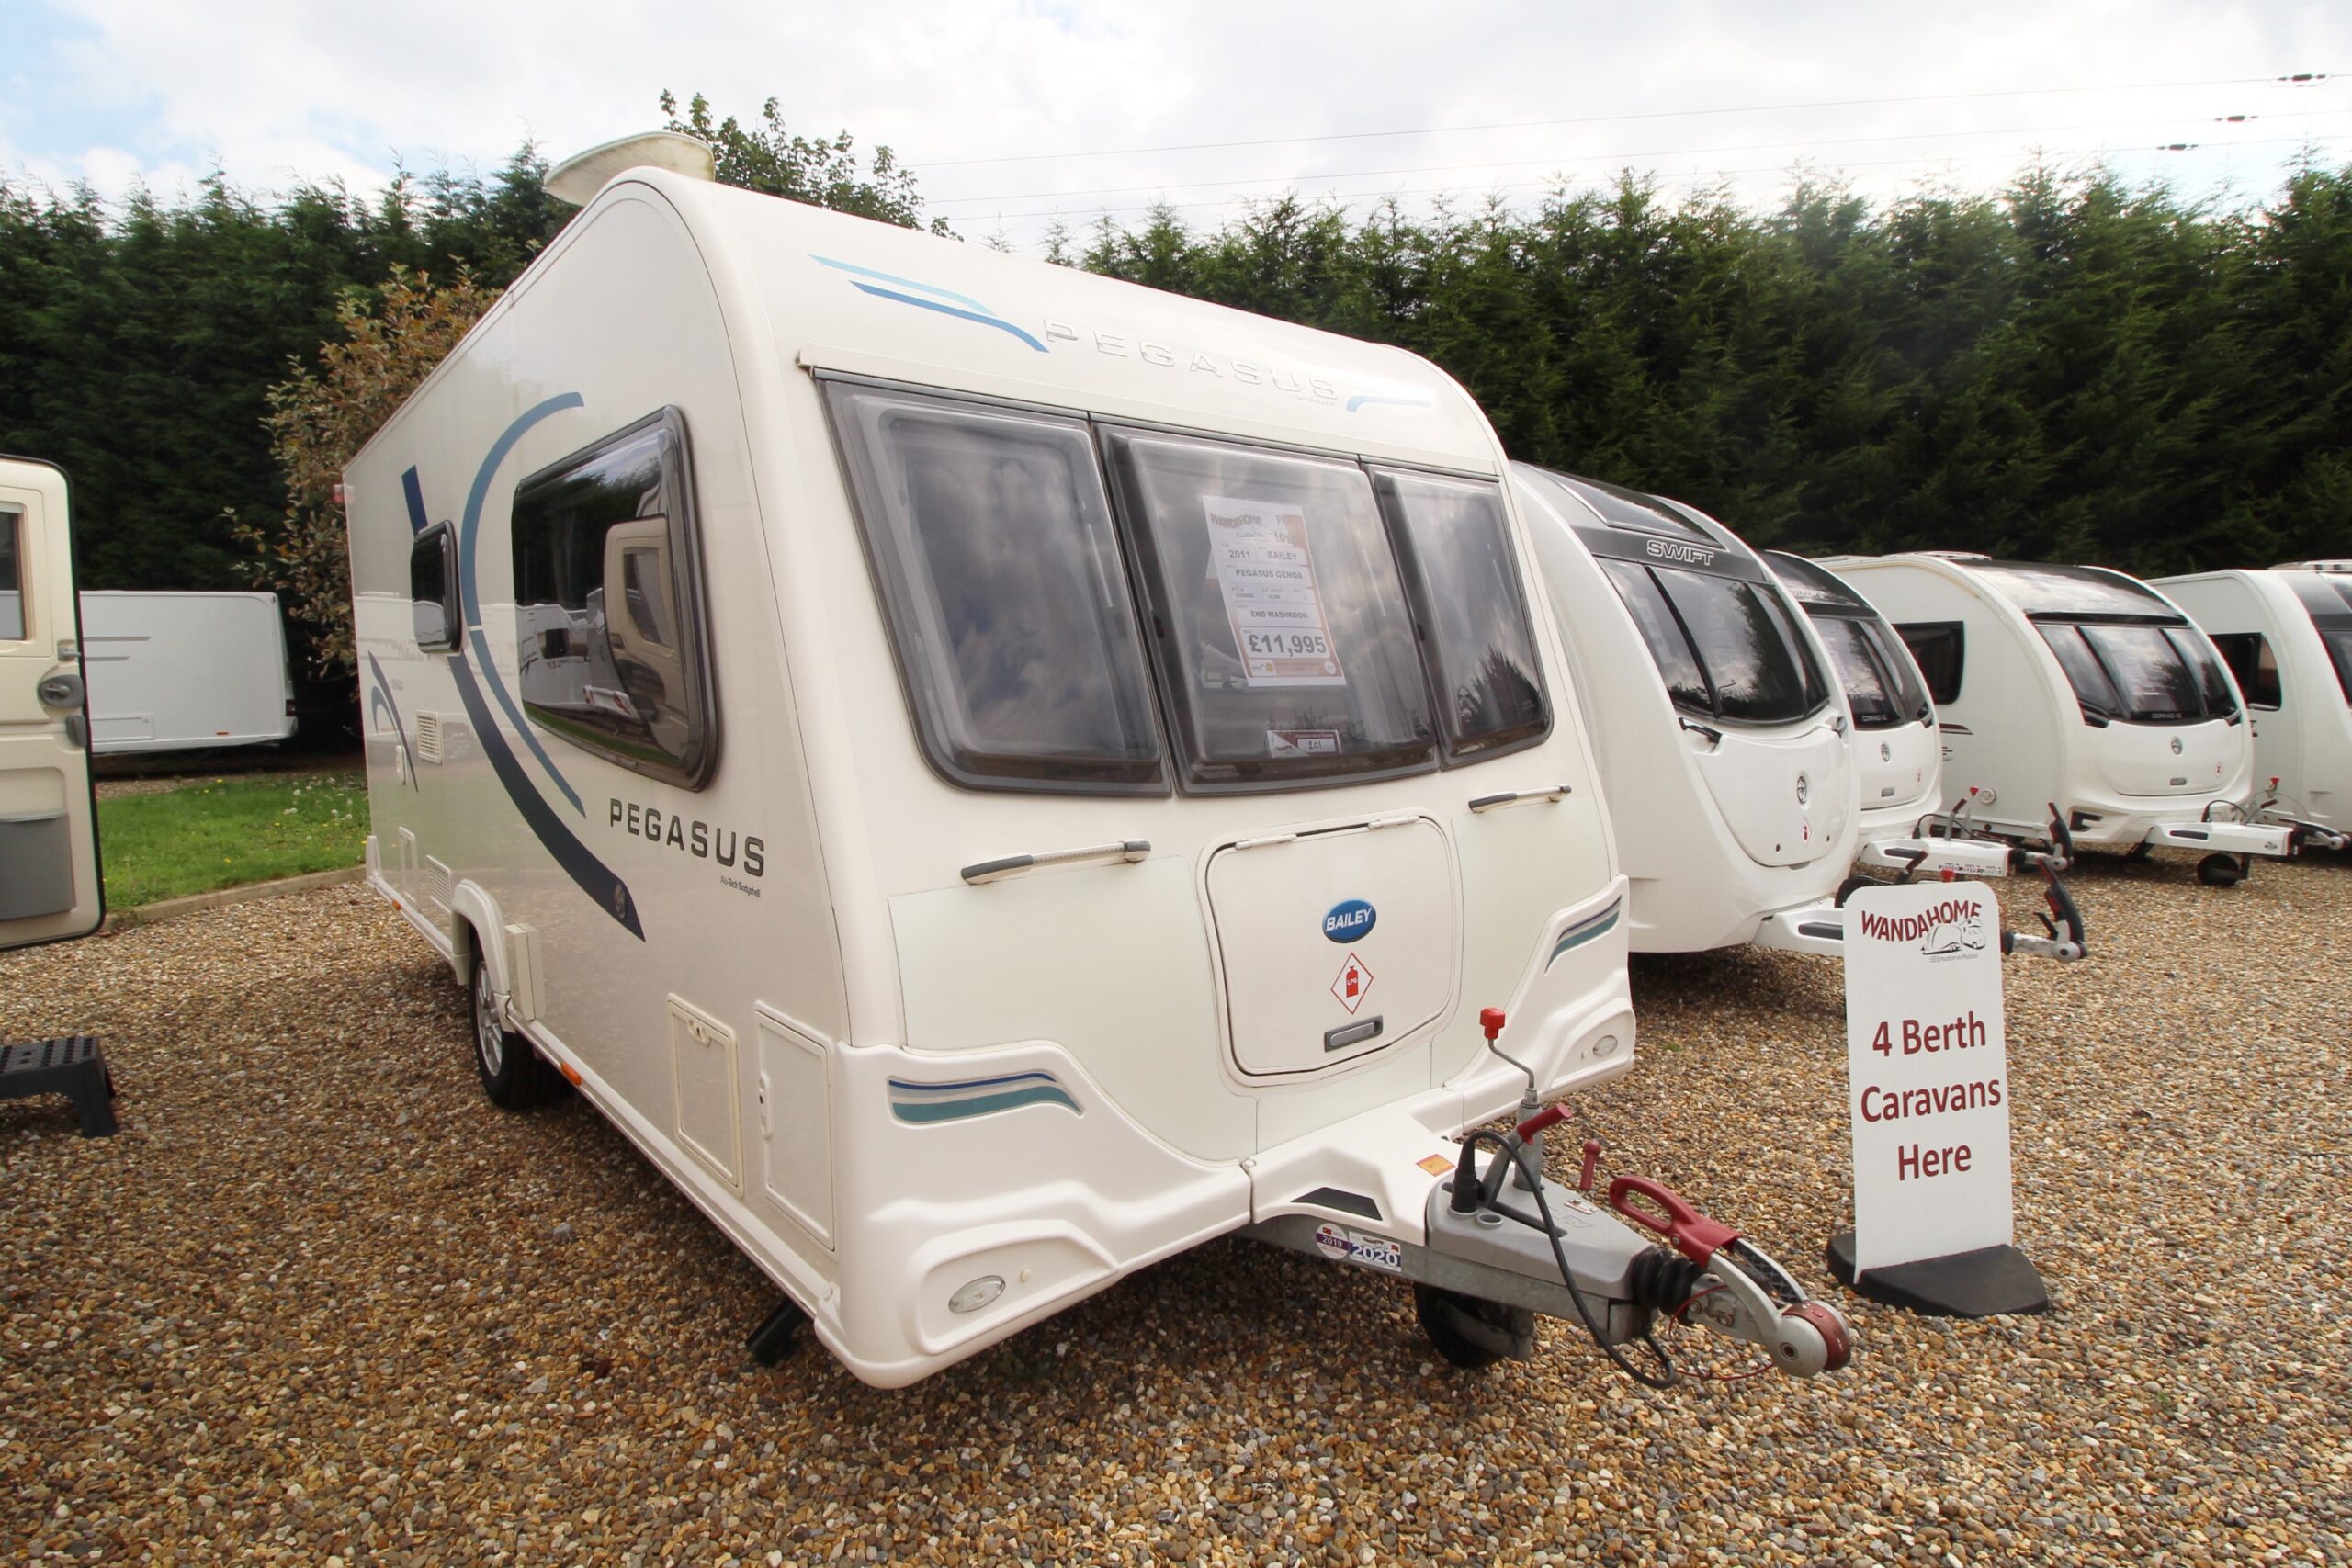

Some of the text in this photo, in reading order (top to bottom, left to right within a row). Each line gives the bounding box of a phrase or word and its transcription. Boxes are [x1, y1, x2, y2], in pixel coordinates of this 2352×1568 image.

[1044, 318, 1338, 400] PEGASUS
[1228, 549, 1297, 560] 2011 BAILEY
[1646, 539, 1714, 566] SWIFT
[1236, 569, 1304, 580] PEGASUS GENOA
[1250, 610, 1308, 619] END WASHROOM
[1249, 634, 1327, 658] £11,995
[610, 798, 764, 877] PEGASUS
[1326, 908, 1373, 932] BAILEY
[1860, 899, 1982, 942] WANDAHOME
[1872, 1010, 1986, 1056] 4 Berth
[1860, 1078, 2001, 1122] Caravans
[1897, 1144, 1972, 1181] Here
[1323, 1235, 1342, 1247] 2019
[1351, 1245, 1398, 1266] 2020
